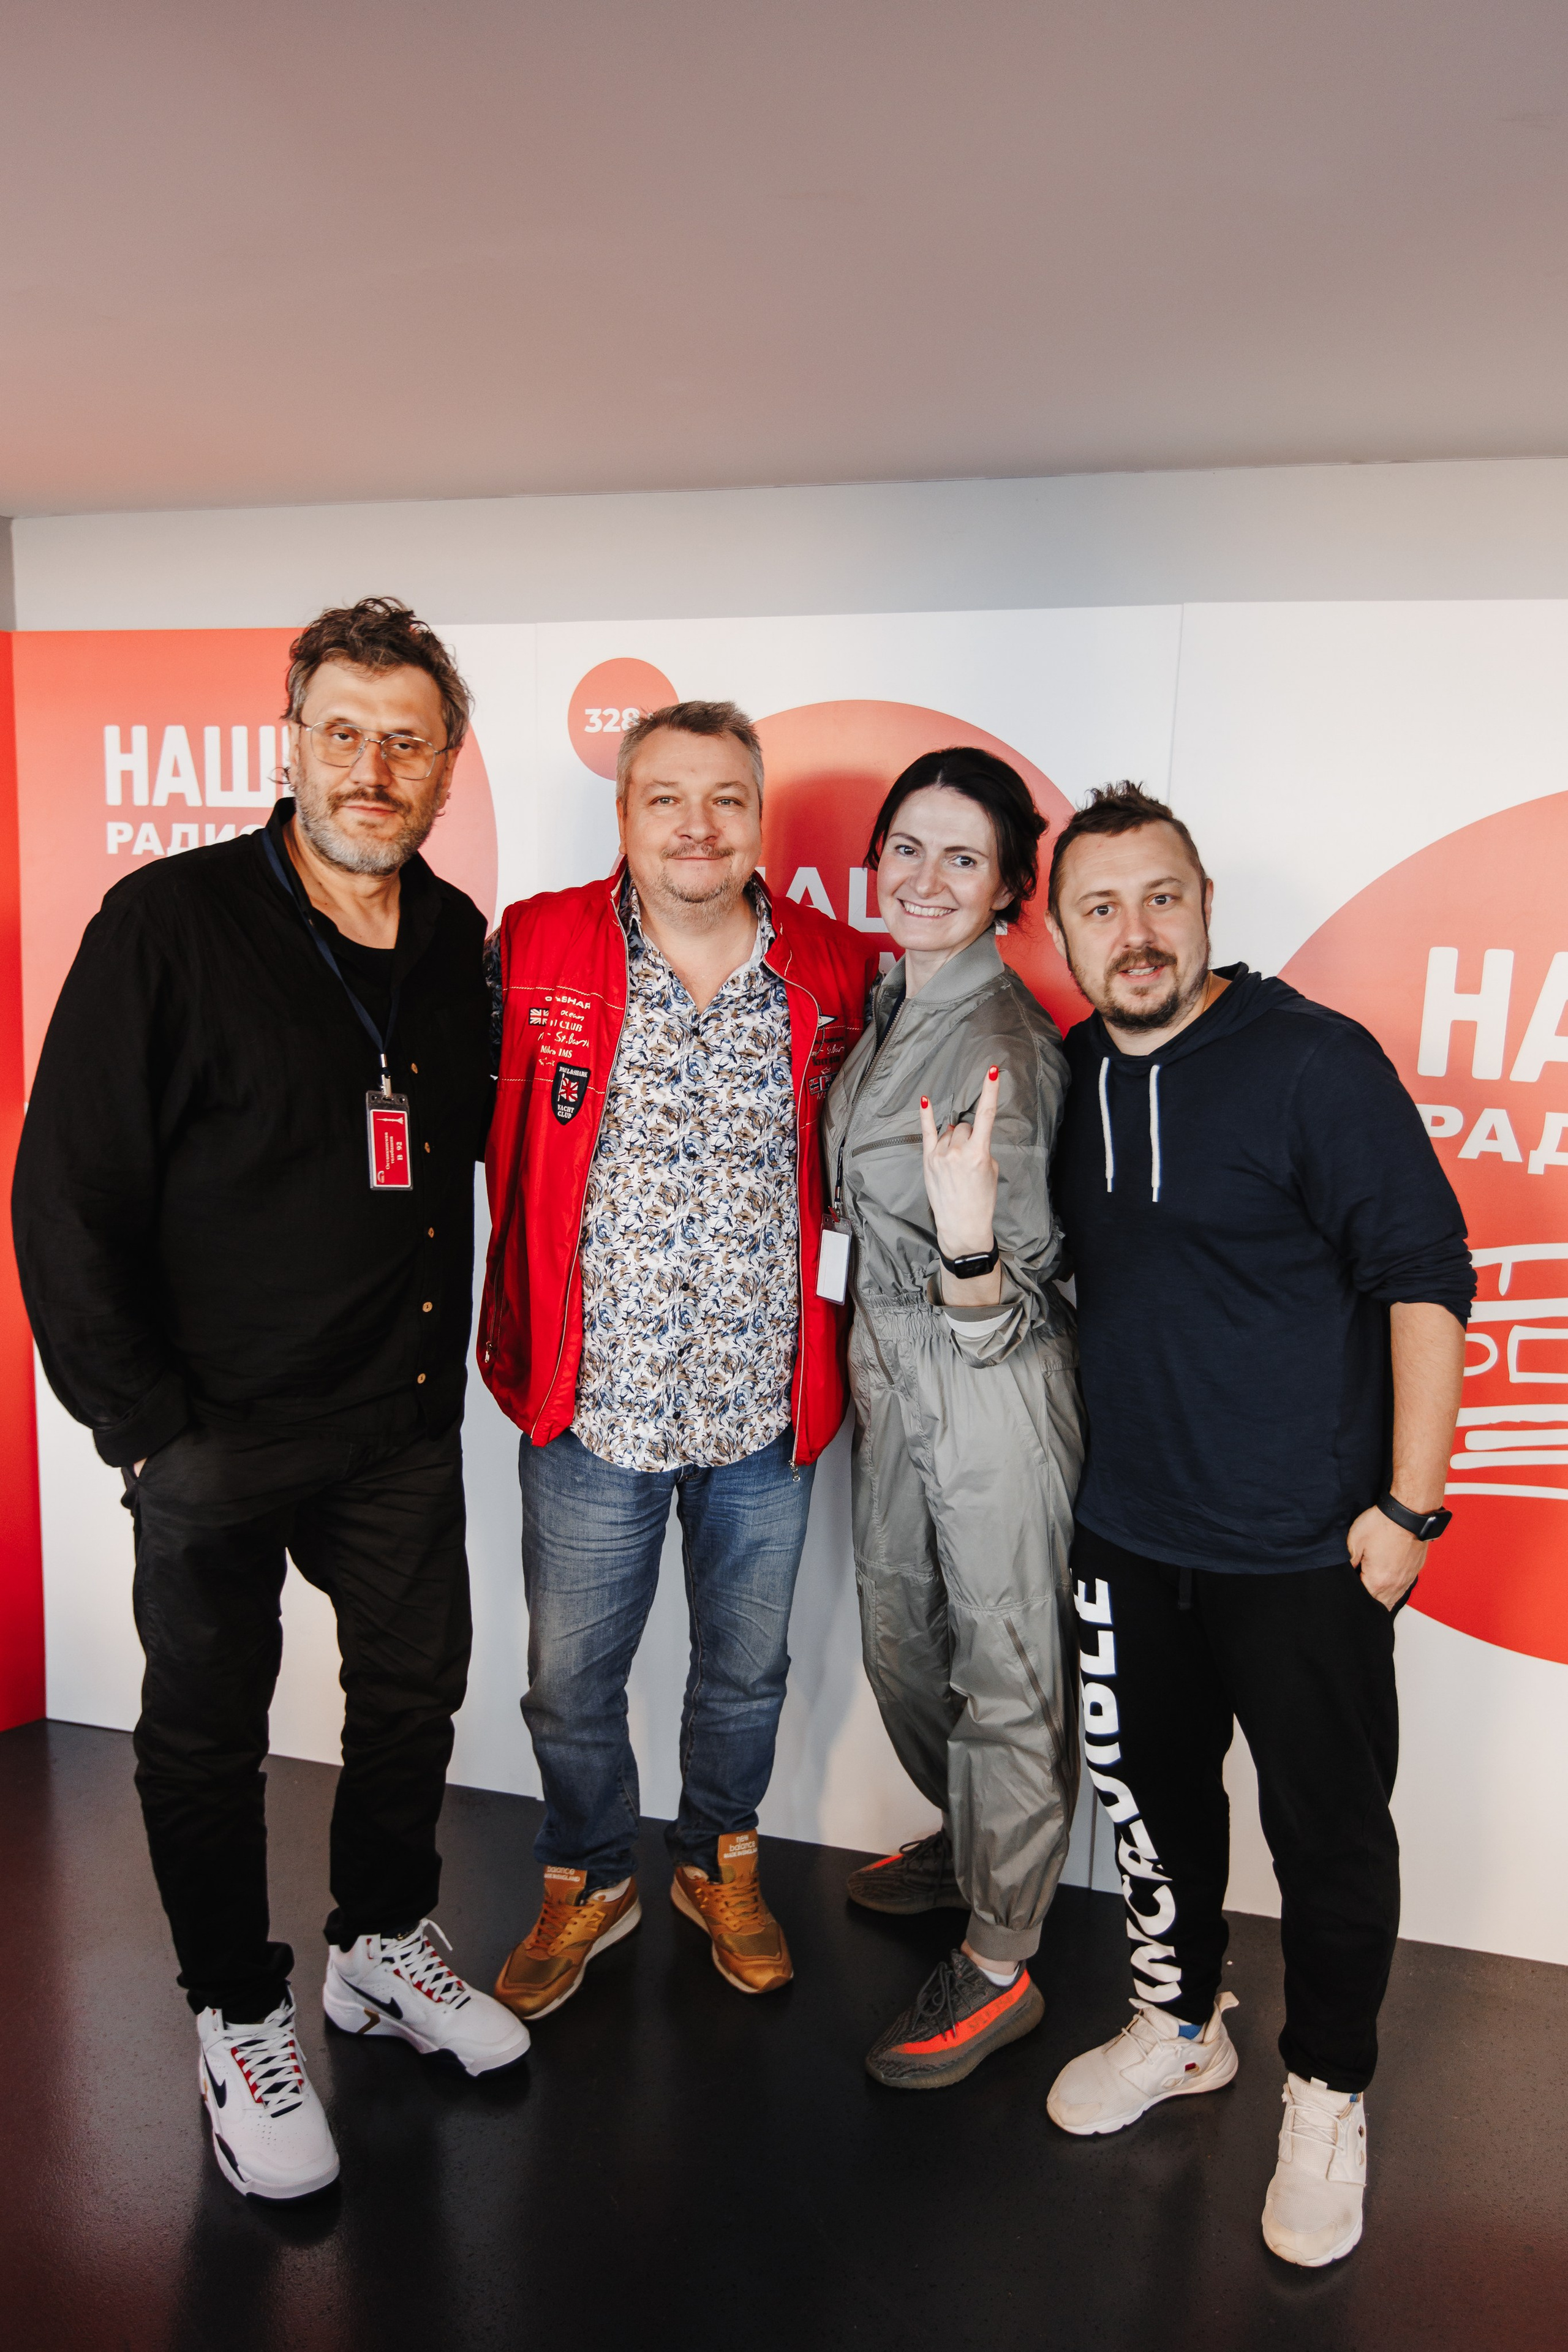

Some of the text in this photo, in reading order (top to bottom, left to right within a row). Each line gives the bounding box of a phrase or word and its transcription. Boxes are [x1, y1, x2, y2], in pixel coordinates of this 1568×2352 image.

[559, 1020, 582, 1032] CLUB
[557, 1104, 575, 1113] YACHT
[557, 1111, 572, 1122] CLUB
